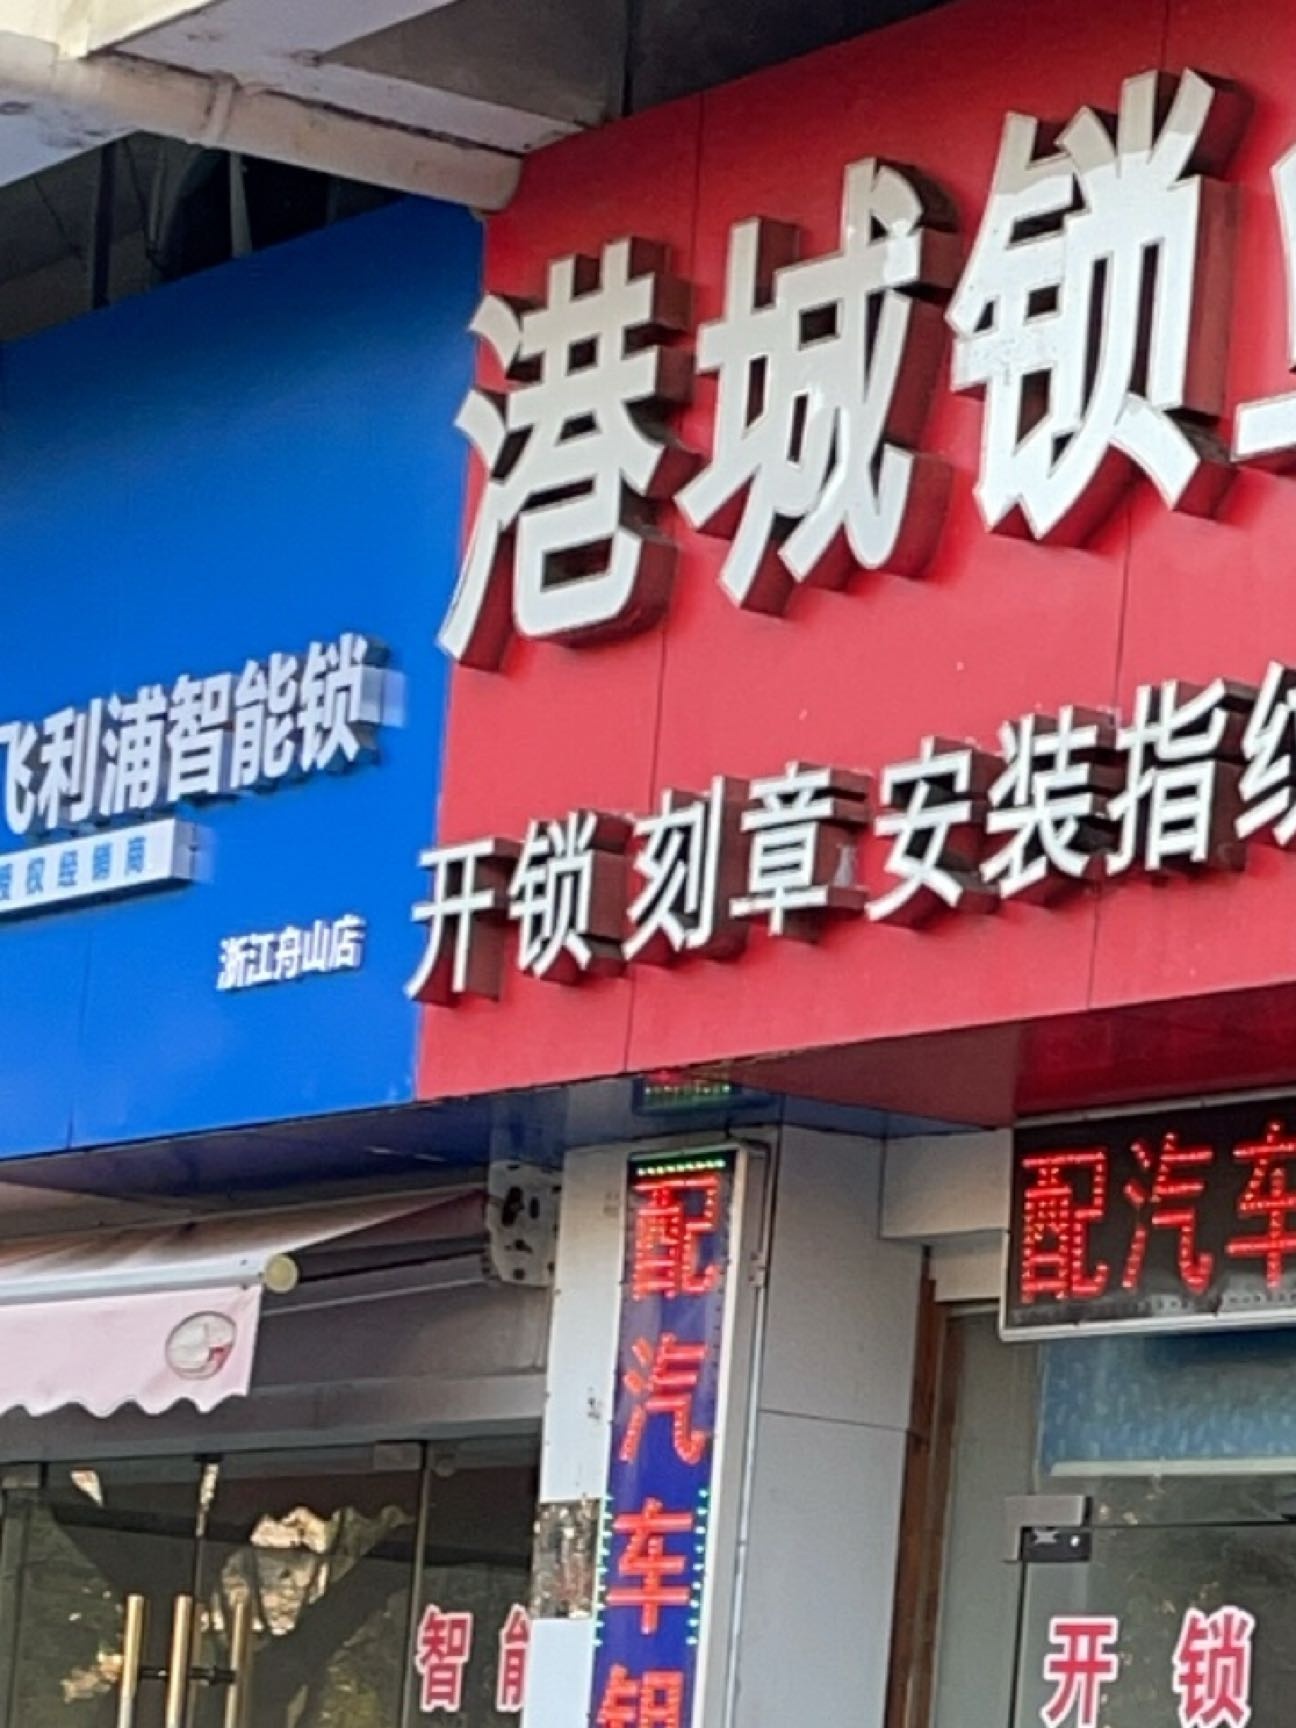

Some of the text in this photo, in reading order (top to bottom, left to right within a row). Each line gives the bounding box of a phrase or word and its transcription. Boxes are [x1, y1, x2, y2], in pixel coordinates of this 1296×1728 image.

[0, 633, 367, 835] 飞利浦智能锁
[217, 915, 365, 991] 浙江舟山店
